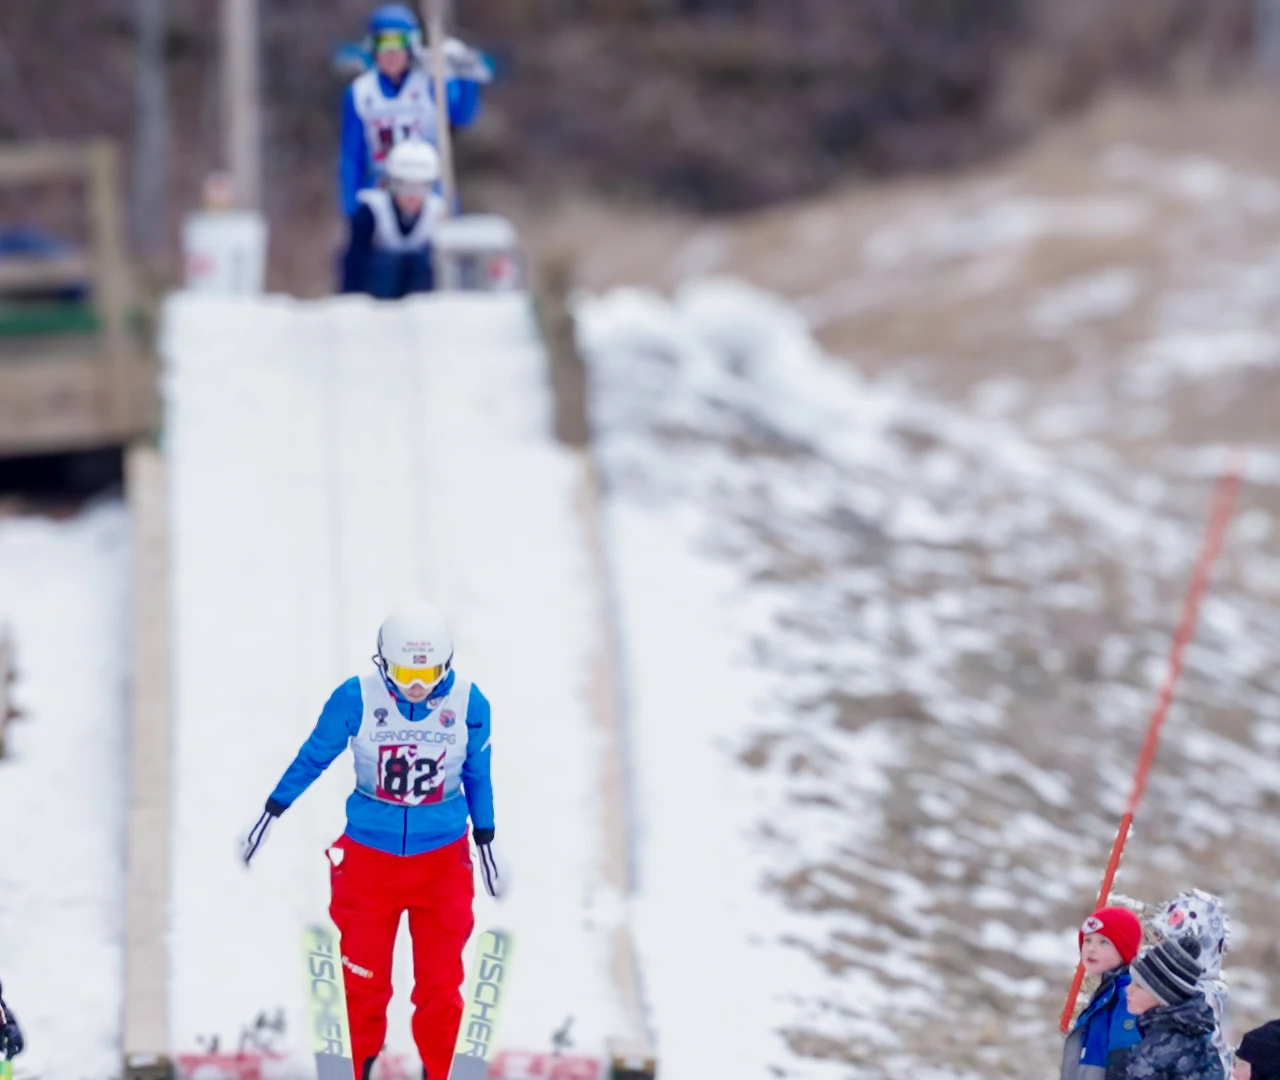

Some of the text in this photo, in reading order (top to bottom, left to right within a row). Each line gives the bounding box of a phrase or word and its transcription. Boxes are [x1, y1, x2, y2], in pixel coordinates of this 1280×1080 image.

[370, 730, 456, 745] USANORDIC.ORG
[384, 757, 438, 798] 82
[466, 929, 509, 1058] FISCHER
